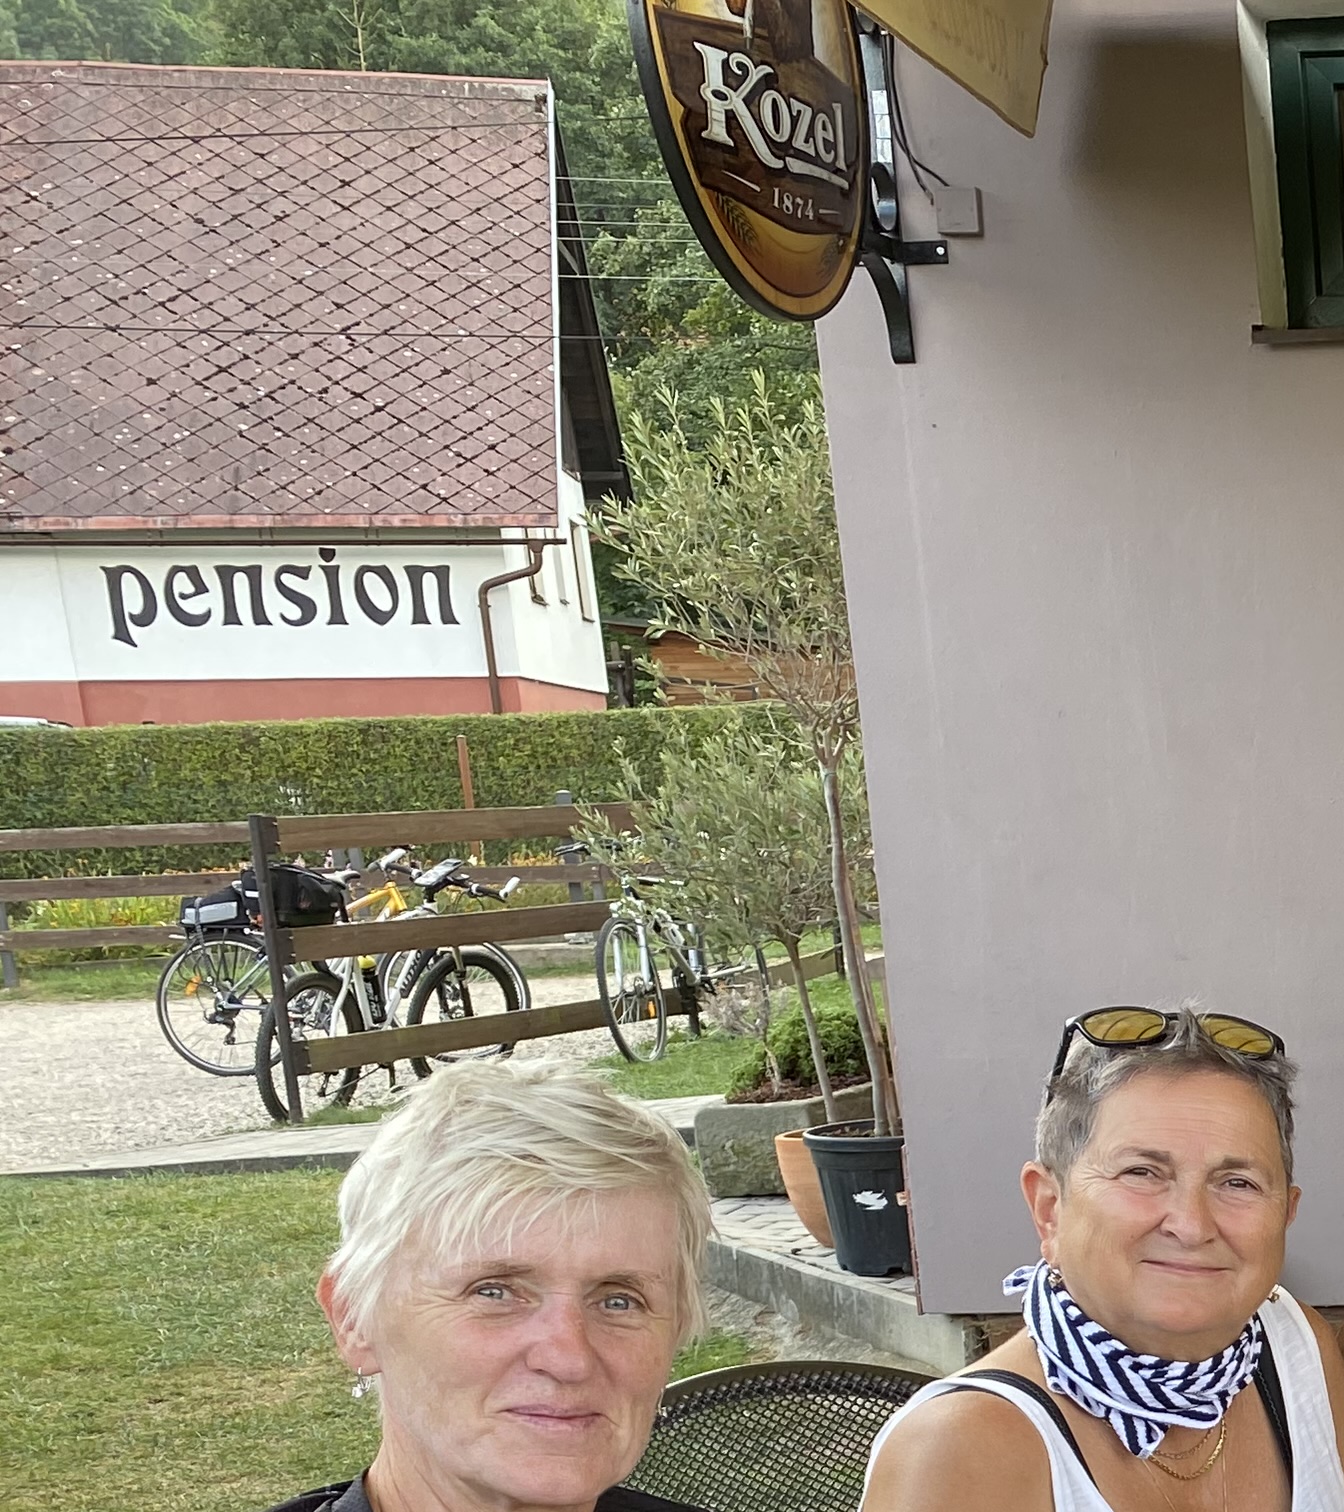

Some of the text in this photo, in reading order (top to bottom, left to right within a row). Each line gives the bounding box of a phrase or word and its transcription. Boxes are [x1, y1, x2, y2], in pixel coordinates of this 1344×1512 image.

[693, 41, 848, 172] Kozel
[771, 187, 815, 221] 1874
[100, 548, 460, 648] pension
[400, 948, 423, 993] AUTHO
